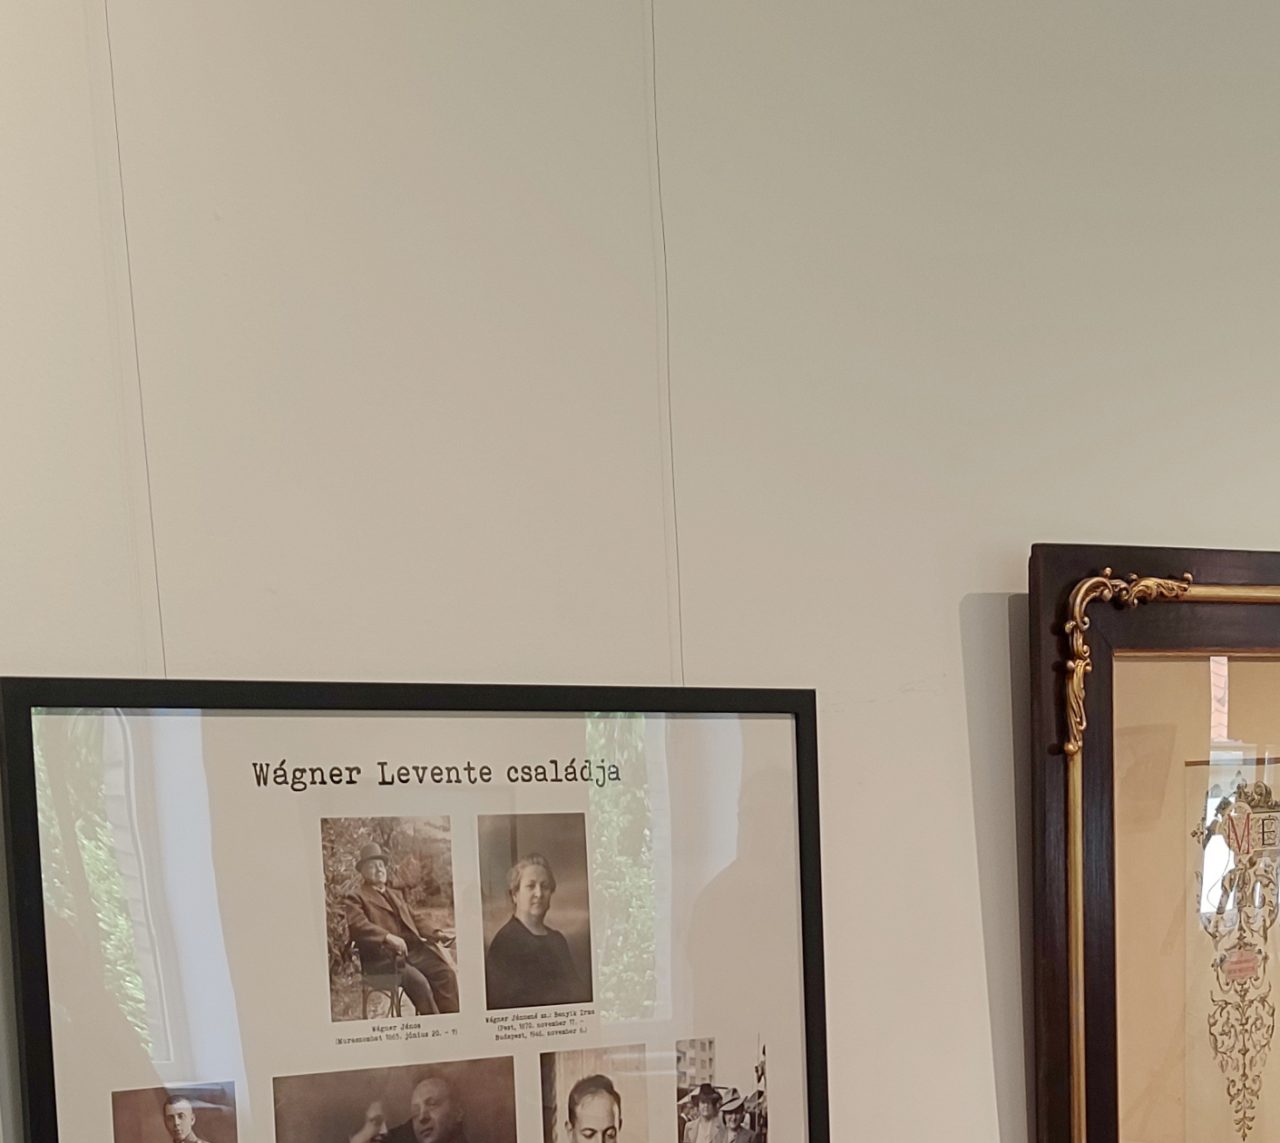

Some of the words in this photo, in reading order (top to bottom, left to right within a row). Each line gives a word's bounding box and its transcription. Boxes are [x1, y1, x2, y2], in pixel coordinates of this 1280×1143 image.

[252, 760, 361, 792] Wágner
[377, 761, 493, 786] Levente
[506, 758, 621, 787] családja
